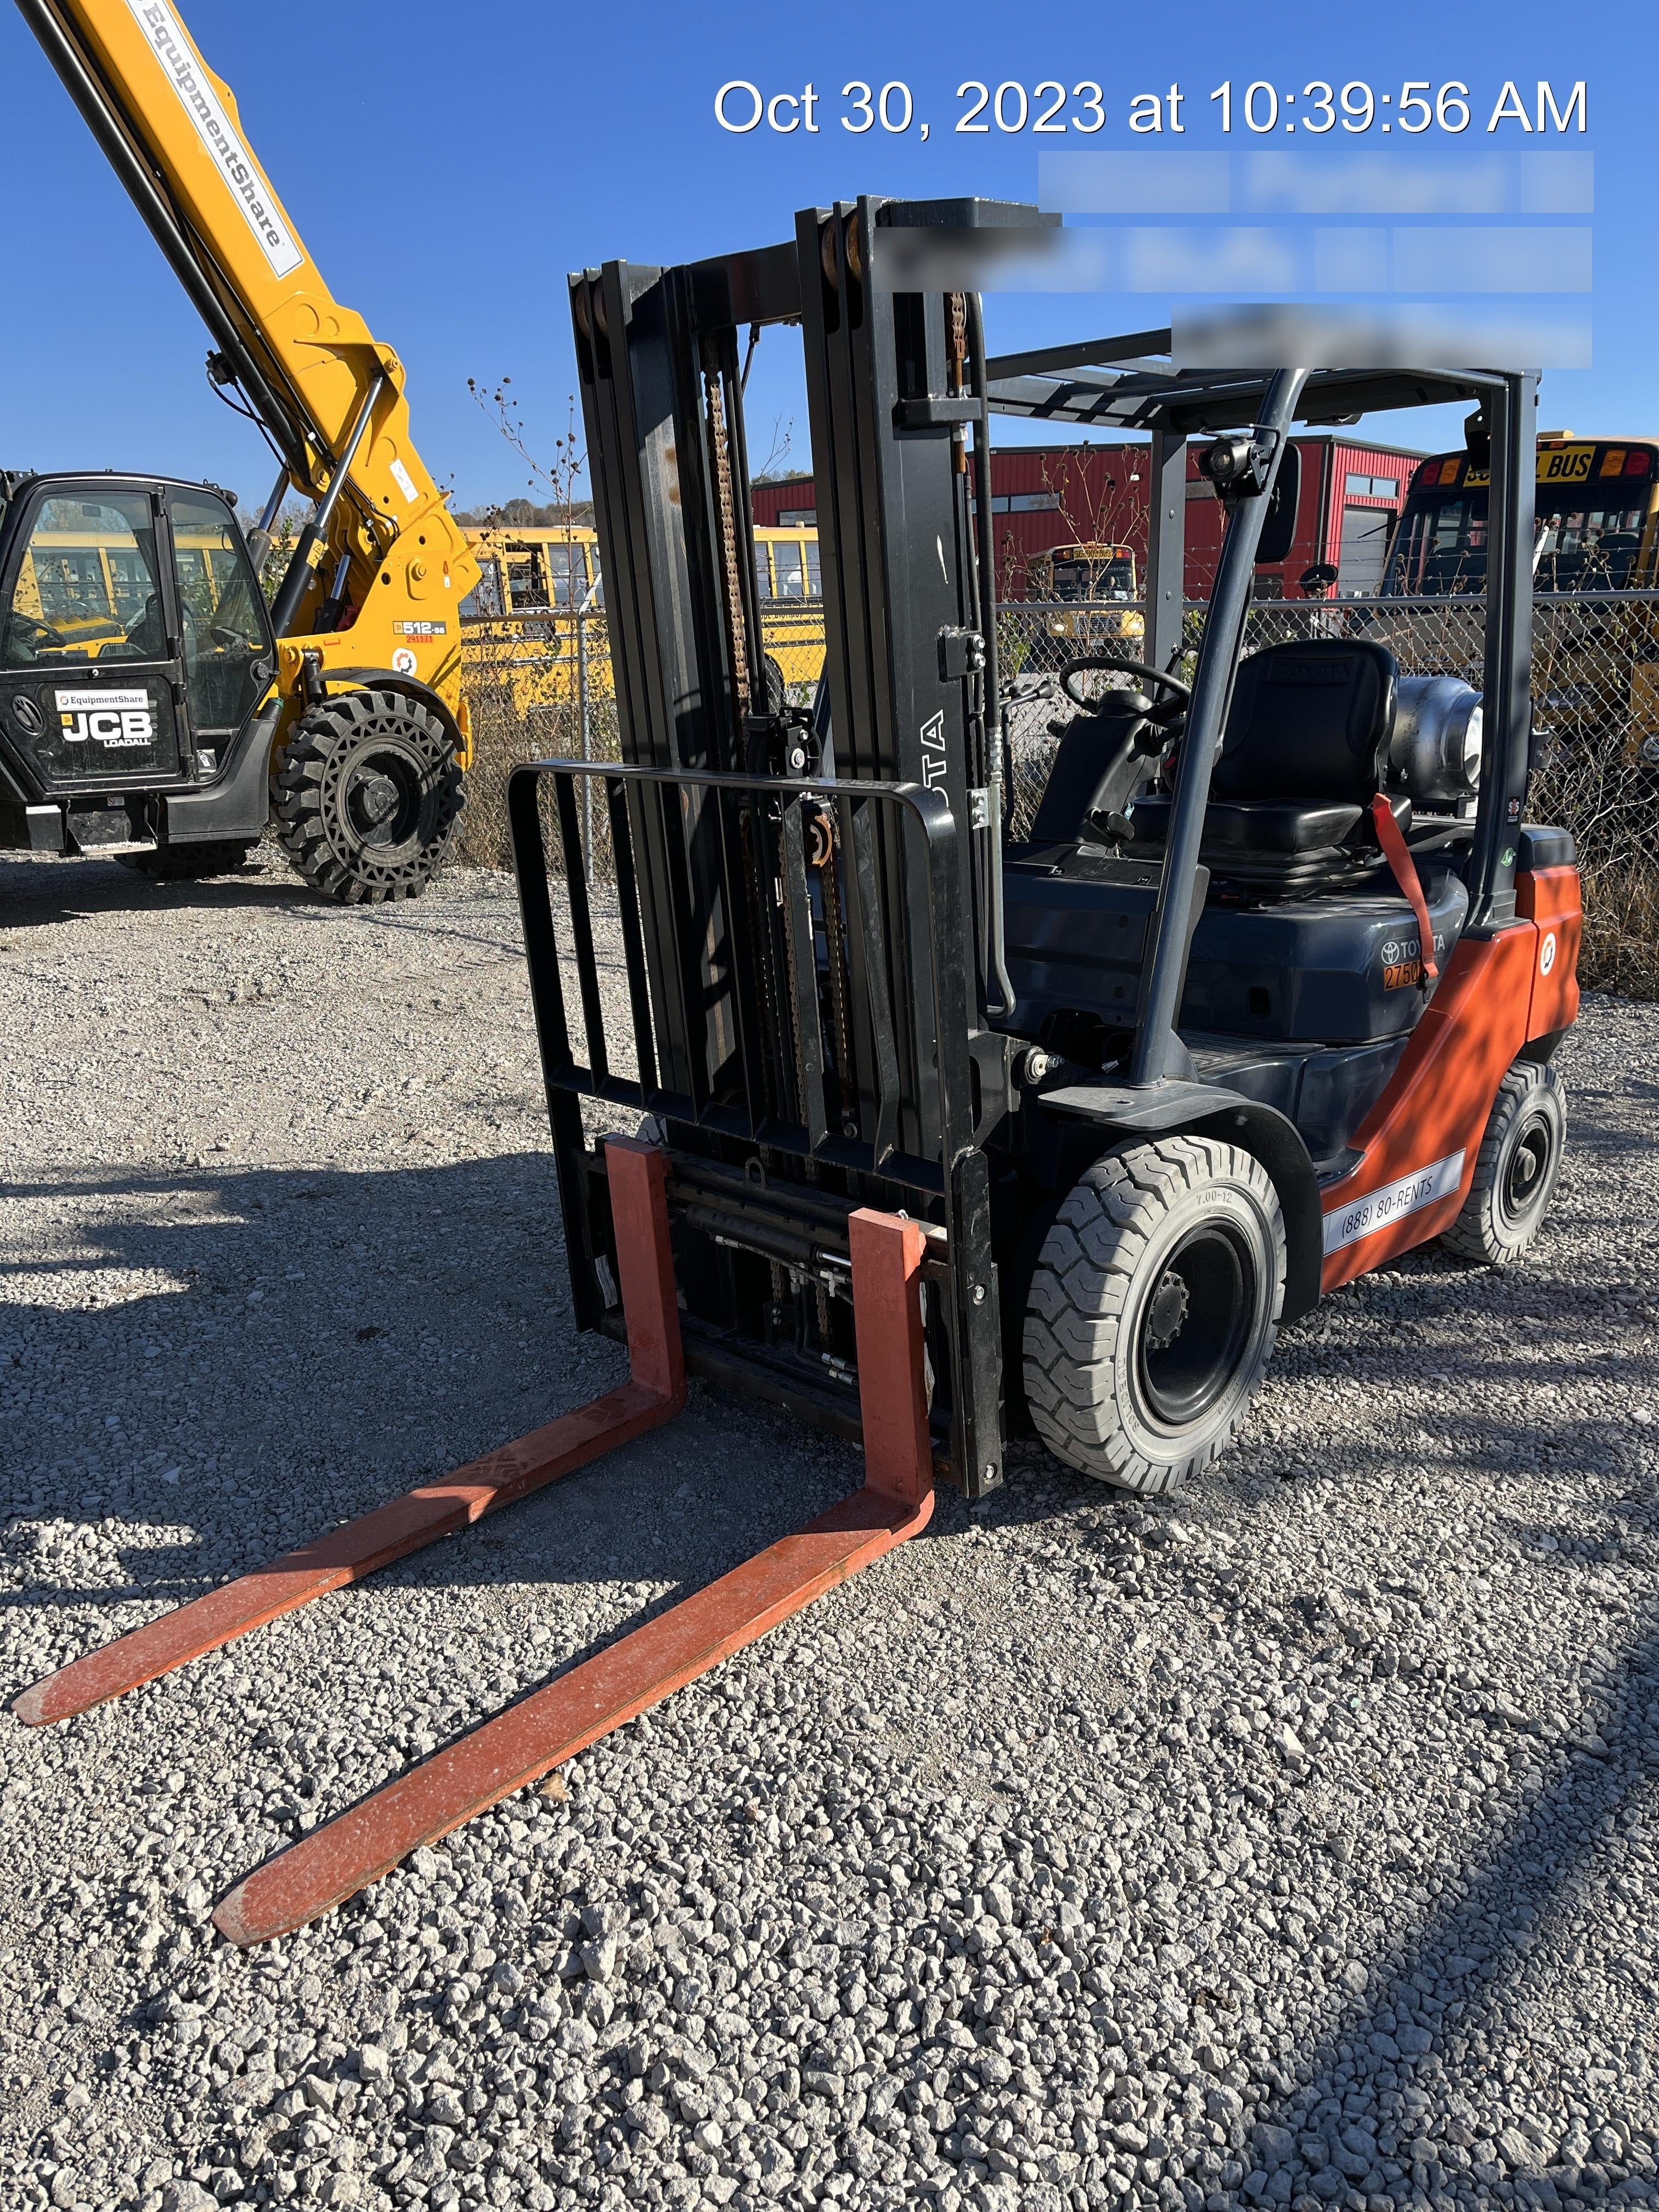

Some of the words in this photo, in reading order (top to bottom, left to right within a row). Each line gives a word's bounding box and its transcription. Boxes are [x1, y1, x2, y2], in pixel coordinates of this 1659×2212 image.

[142, 3, 281, 247] EquipmentShare
[1547, 454, 1591, 478] BUS
[70, 696, 144, 706] EquipmentShare
[62, 712, 153, 741] JCB
[104, 738, 151, 747] LOADALL
[1197, 1189, 1232, 1205] 7.00-12
[1342, 1205, 1373, 1239] (888)
[1376, 1176, 1433, 1219] 80-RENTS
